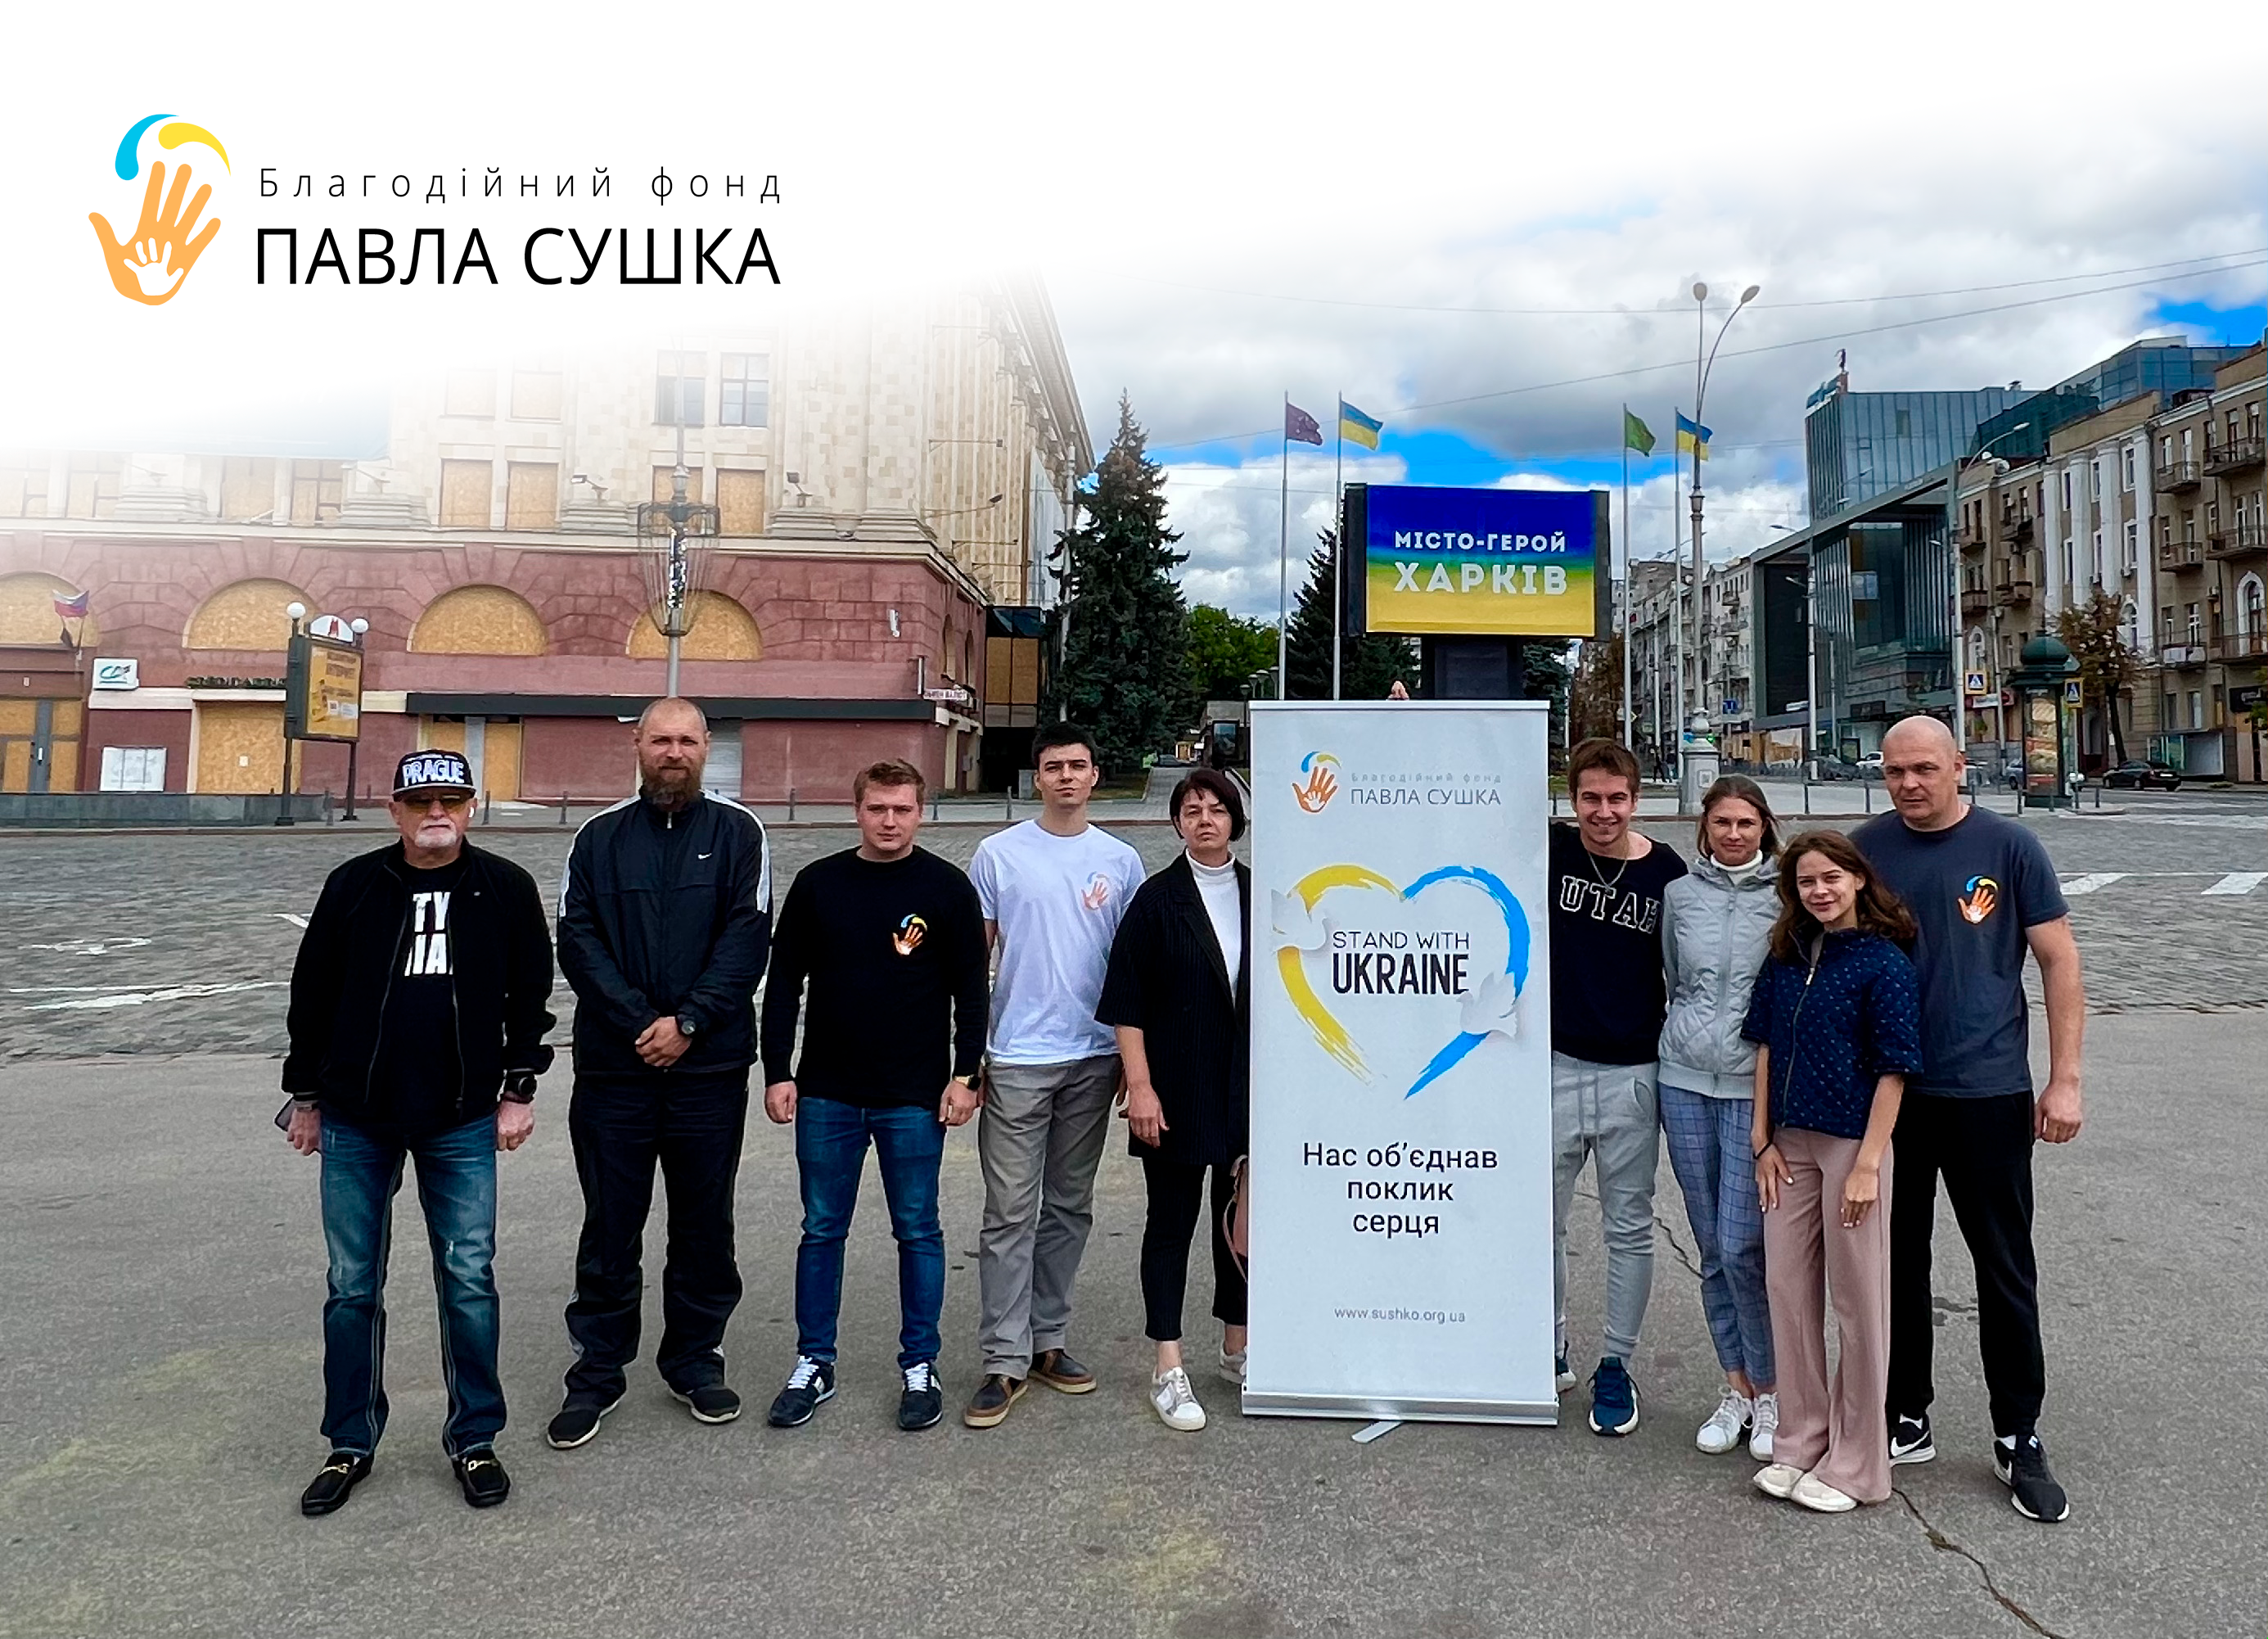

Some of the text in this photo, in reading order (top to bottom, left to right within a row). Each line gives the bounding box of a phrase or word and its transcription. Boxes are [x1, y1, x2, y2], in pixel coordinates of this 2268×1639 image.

[1395, 530, 1567, 553] МІСТО-ГЕРОЙ
[1394, 561, 1567, 595] ХАРКІВ
[403, 759, 465, 788] PRAGUE
[1351, 772, 1501, 784] Благодійний фонд
[1351, 788, 1501, 806] ПАВЛА СУШКА
[1332, 931, 1469, 950] STAND WITH
[1332, 952, 1469, 995] UKRAINE
[1304, 1142, 1357, 1167] Нас
[1347, 1181, 1454, 1201] поклик
[1353, 1214, 1440, 1239] серця
[1334, 1307, 1466, 1325] www.sushko.org.ua
